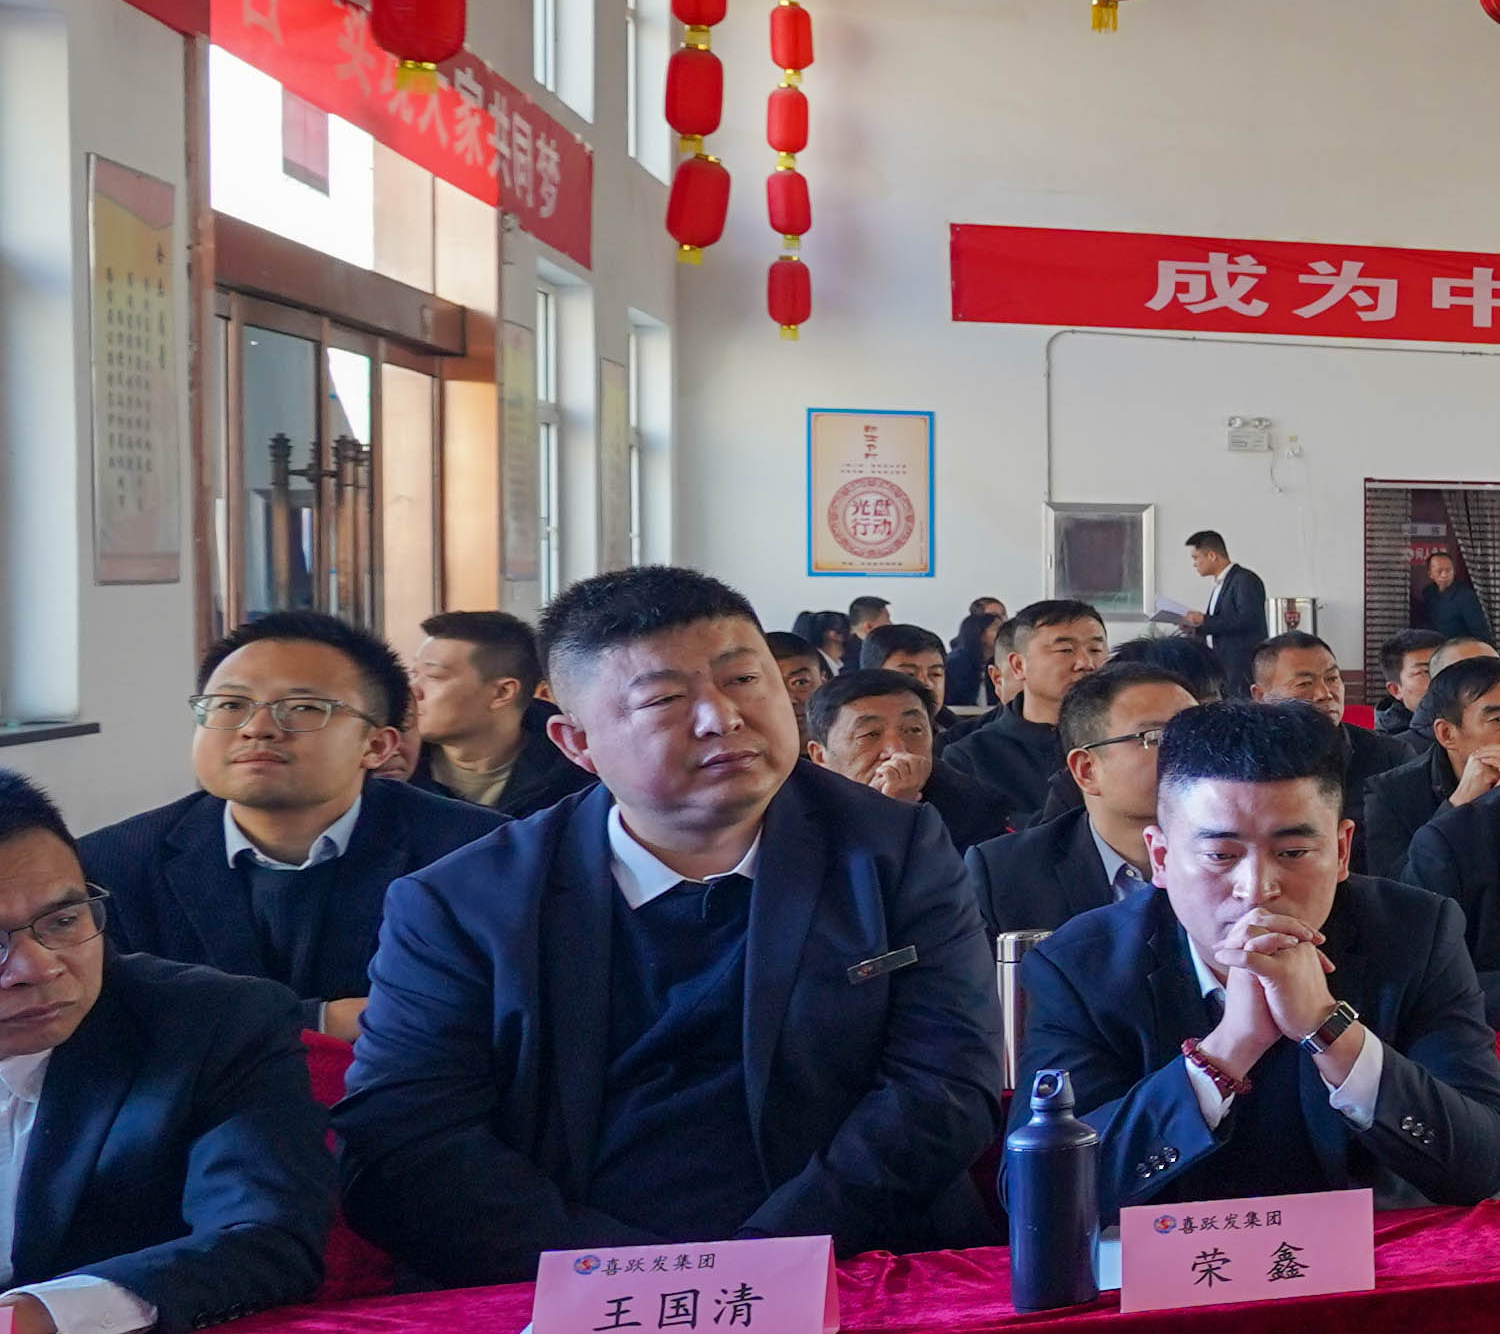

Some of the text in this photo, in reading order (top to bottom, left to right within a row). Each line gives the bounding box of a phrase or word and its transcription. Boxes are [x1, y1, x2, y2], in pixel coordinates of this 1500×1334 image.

[851, 499, 893, 517] 光盘
[851, 518, 893, 537] 行动
[601, 1252, 717, 1276] 喜跃发集团
[592, 1282, 765, 1332] 王国清
